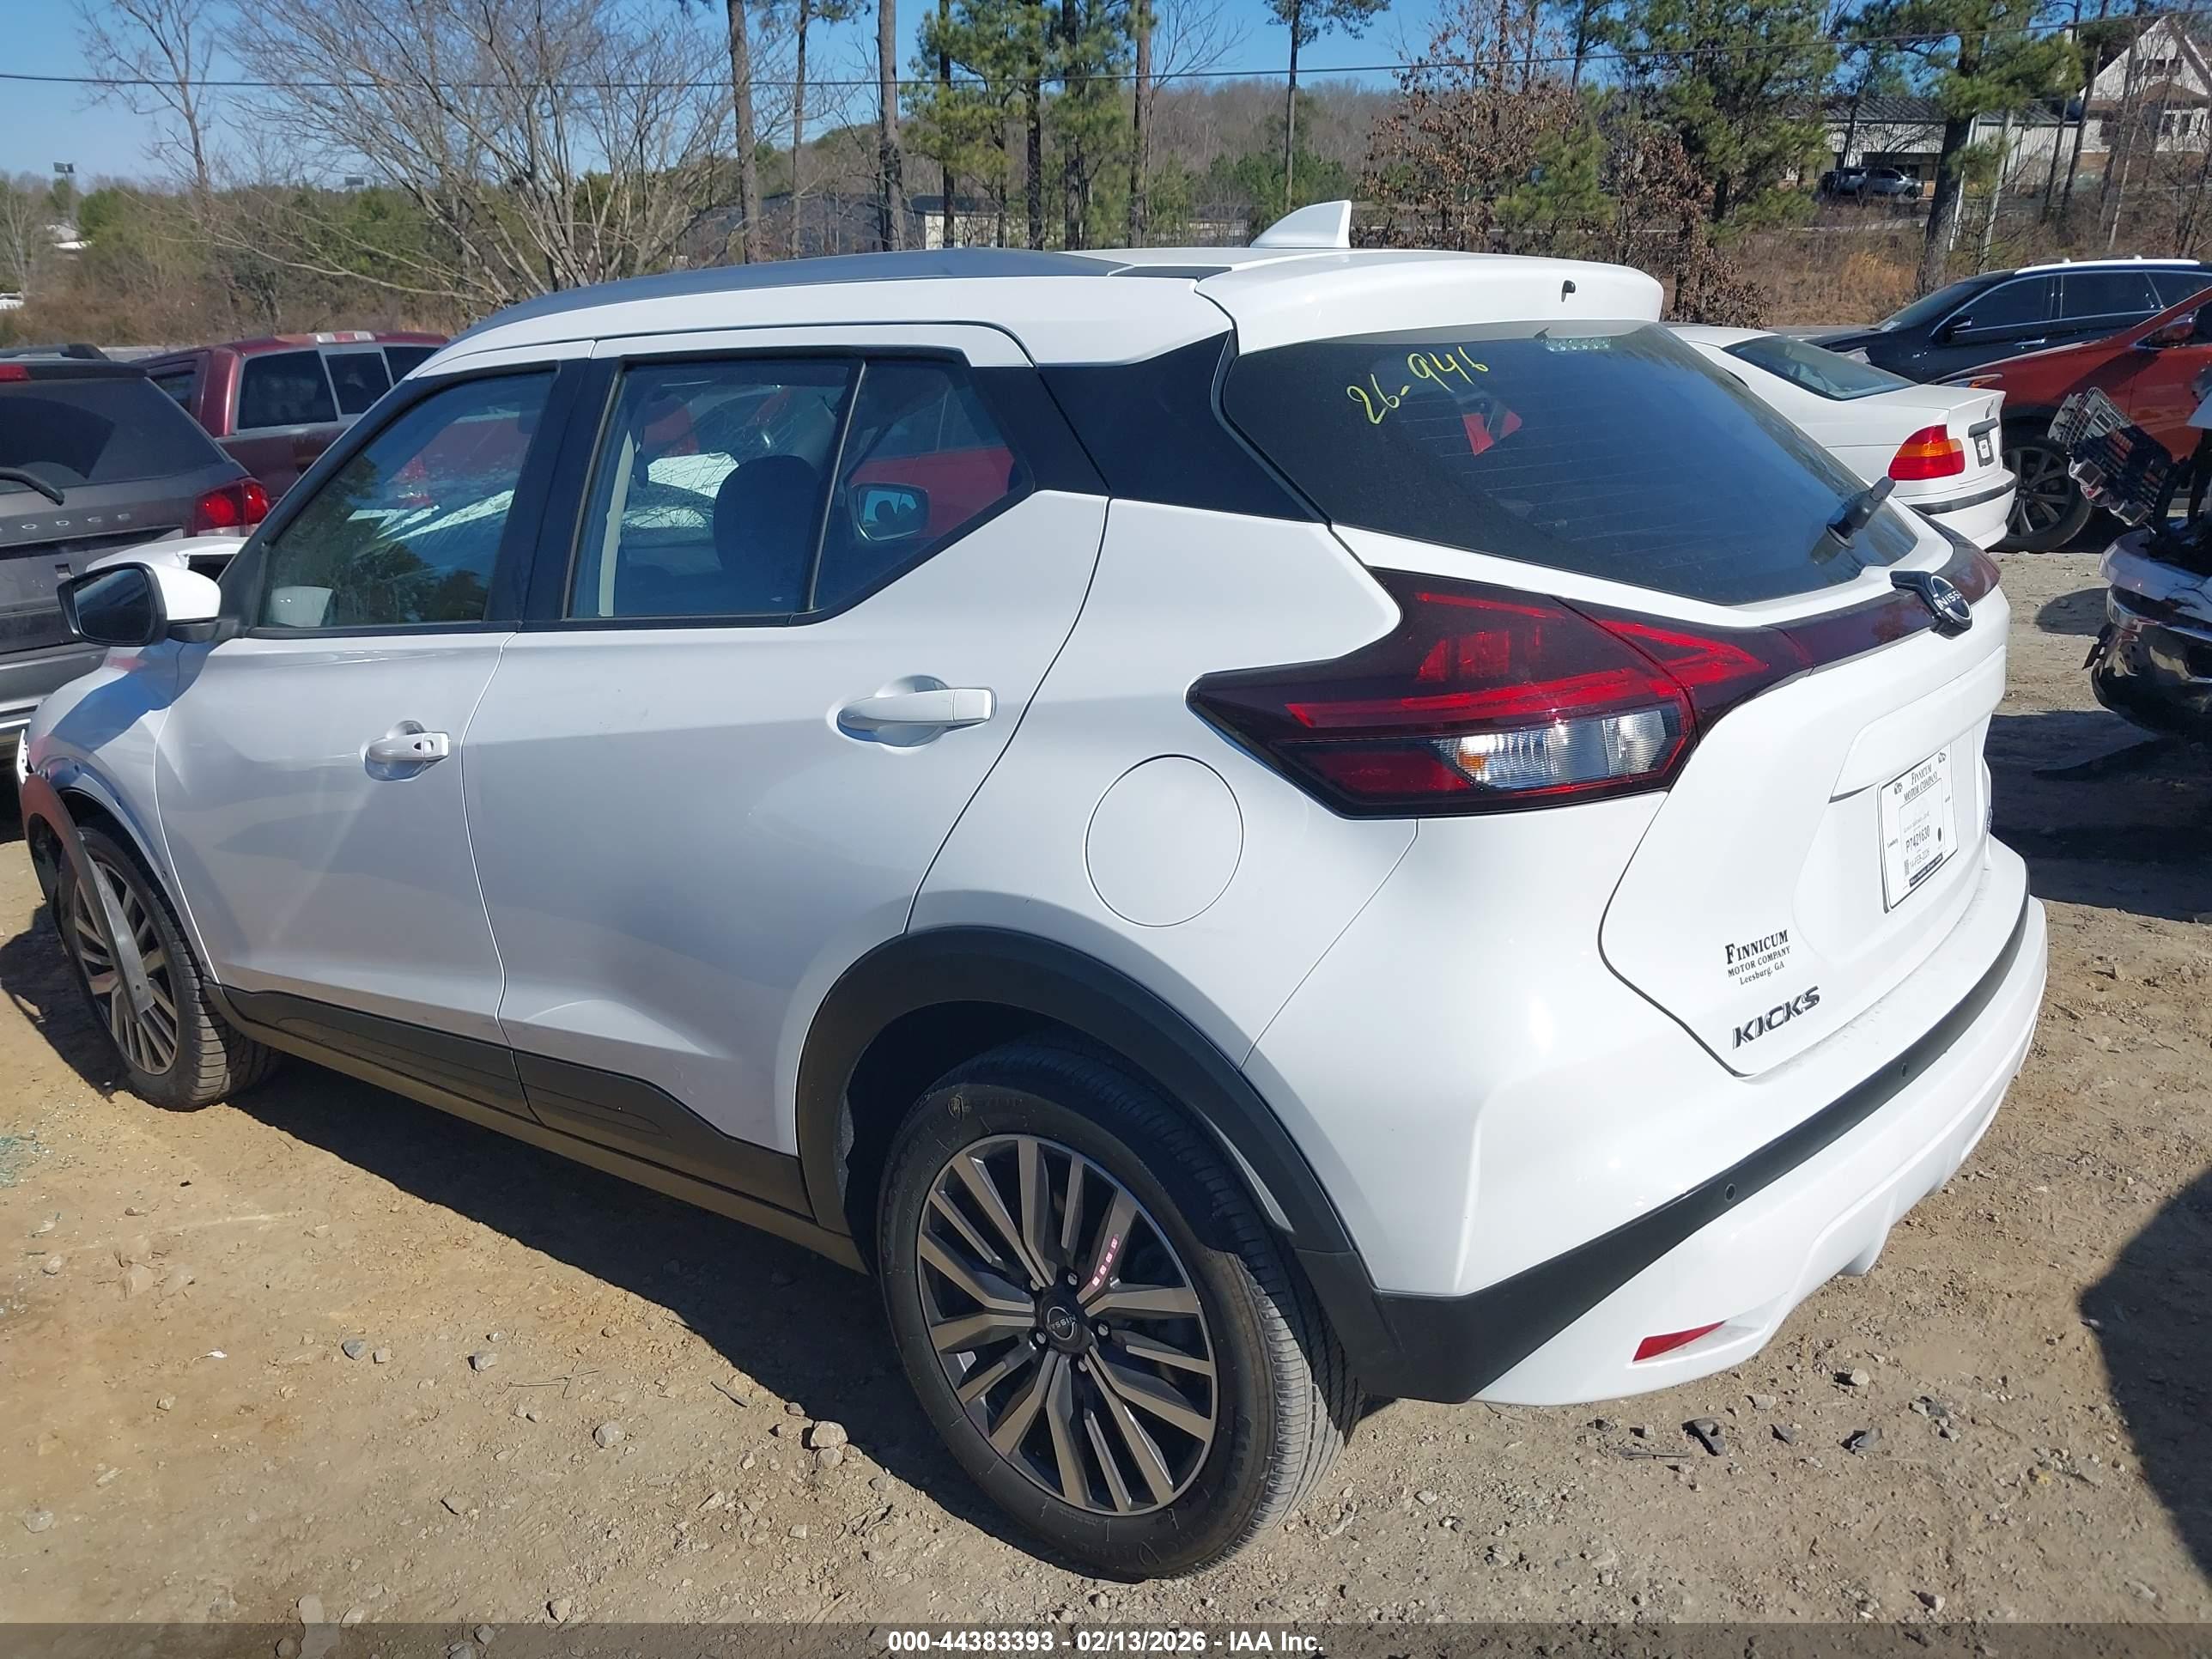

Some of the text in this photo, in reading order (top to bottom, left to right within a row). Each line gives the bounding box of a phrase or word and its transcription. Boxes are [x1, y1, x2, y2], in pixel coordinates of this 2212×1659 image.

[1346, 345, 1490, 424] 26-946
[0, 513, 131, 532] ODGE
[1724, 928, 1789, 965] FINNICUM
[1727, 945, 1791, 978] MOTOR COMPANY
[1739, 960, 1785, 986] Leesburg, GA
[1732, 985, 1820, 1050] KICKS
